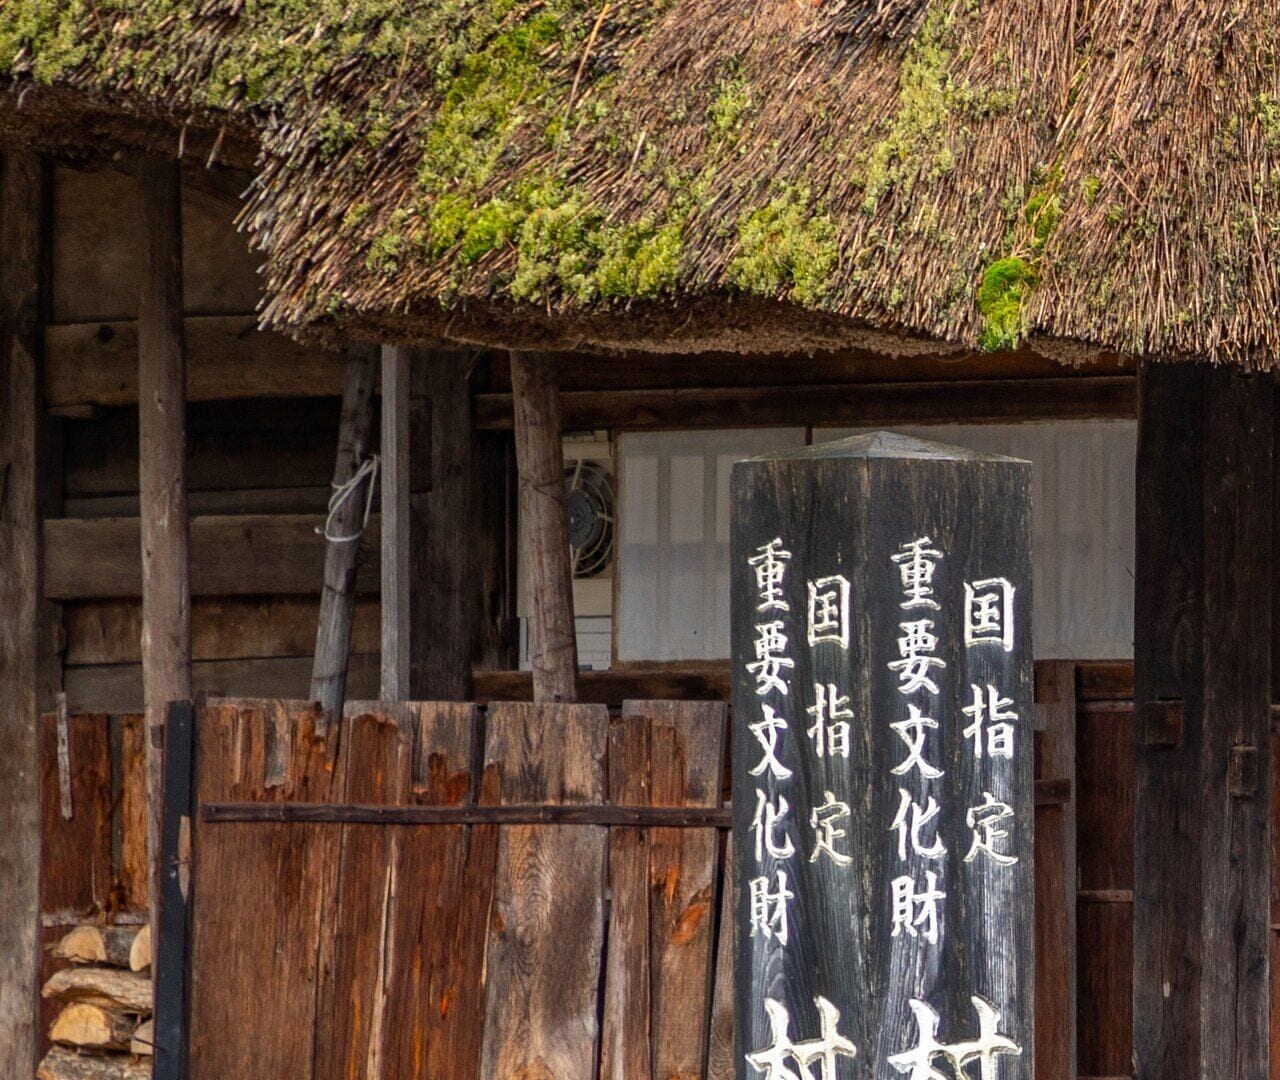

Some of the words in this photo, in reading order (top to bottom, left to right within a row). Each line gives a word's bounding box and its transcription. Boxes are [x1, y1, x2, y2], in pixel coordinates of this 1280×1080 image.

[745, 536, 796, 946] 重要文化財
[806, 574, 854, 867] 国指定
[887, 536, 947, 945] 重要文化財
[962, 576, 1019, 867] 国指定
